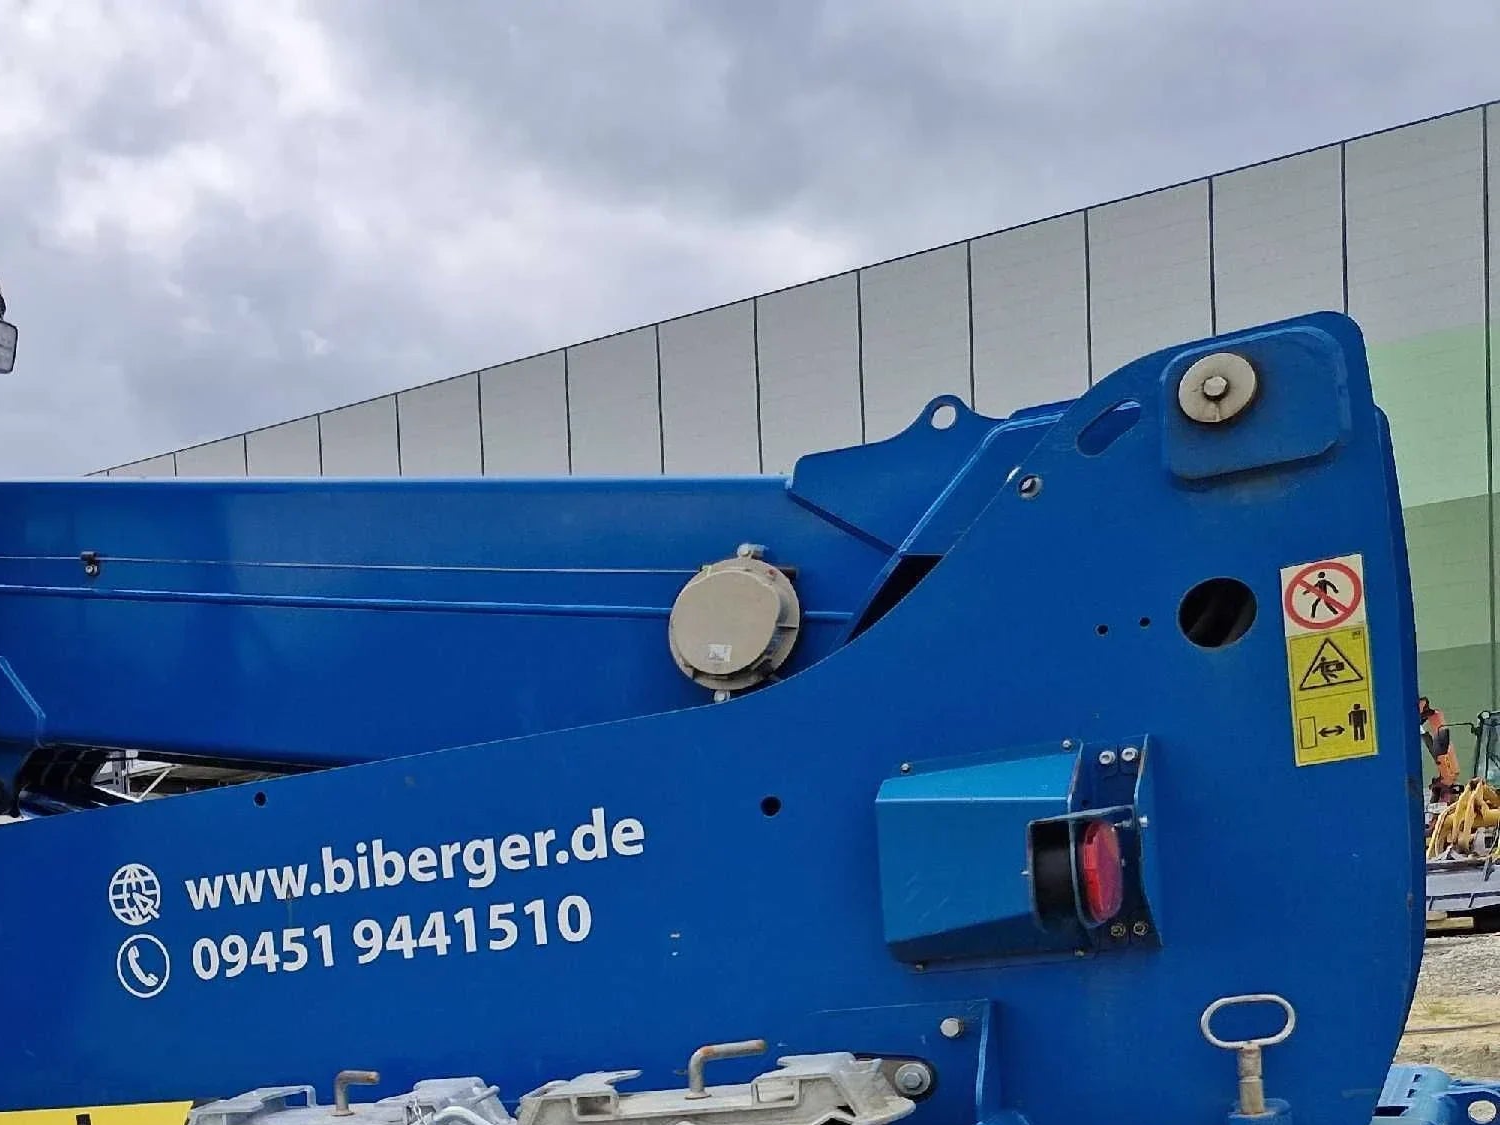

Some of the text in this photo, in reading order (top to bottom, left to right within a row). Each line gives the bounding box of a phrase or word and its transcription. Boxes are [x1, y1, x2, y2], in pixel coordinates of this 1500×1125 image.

[184, 807, 645, 911] www.biberger.de
[192, 895, 592, 981] 09451 9441510
